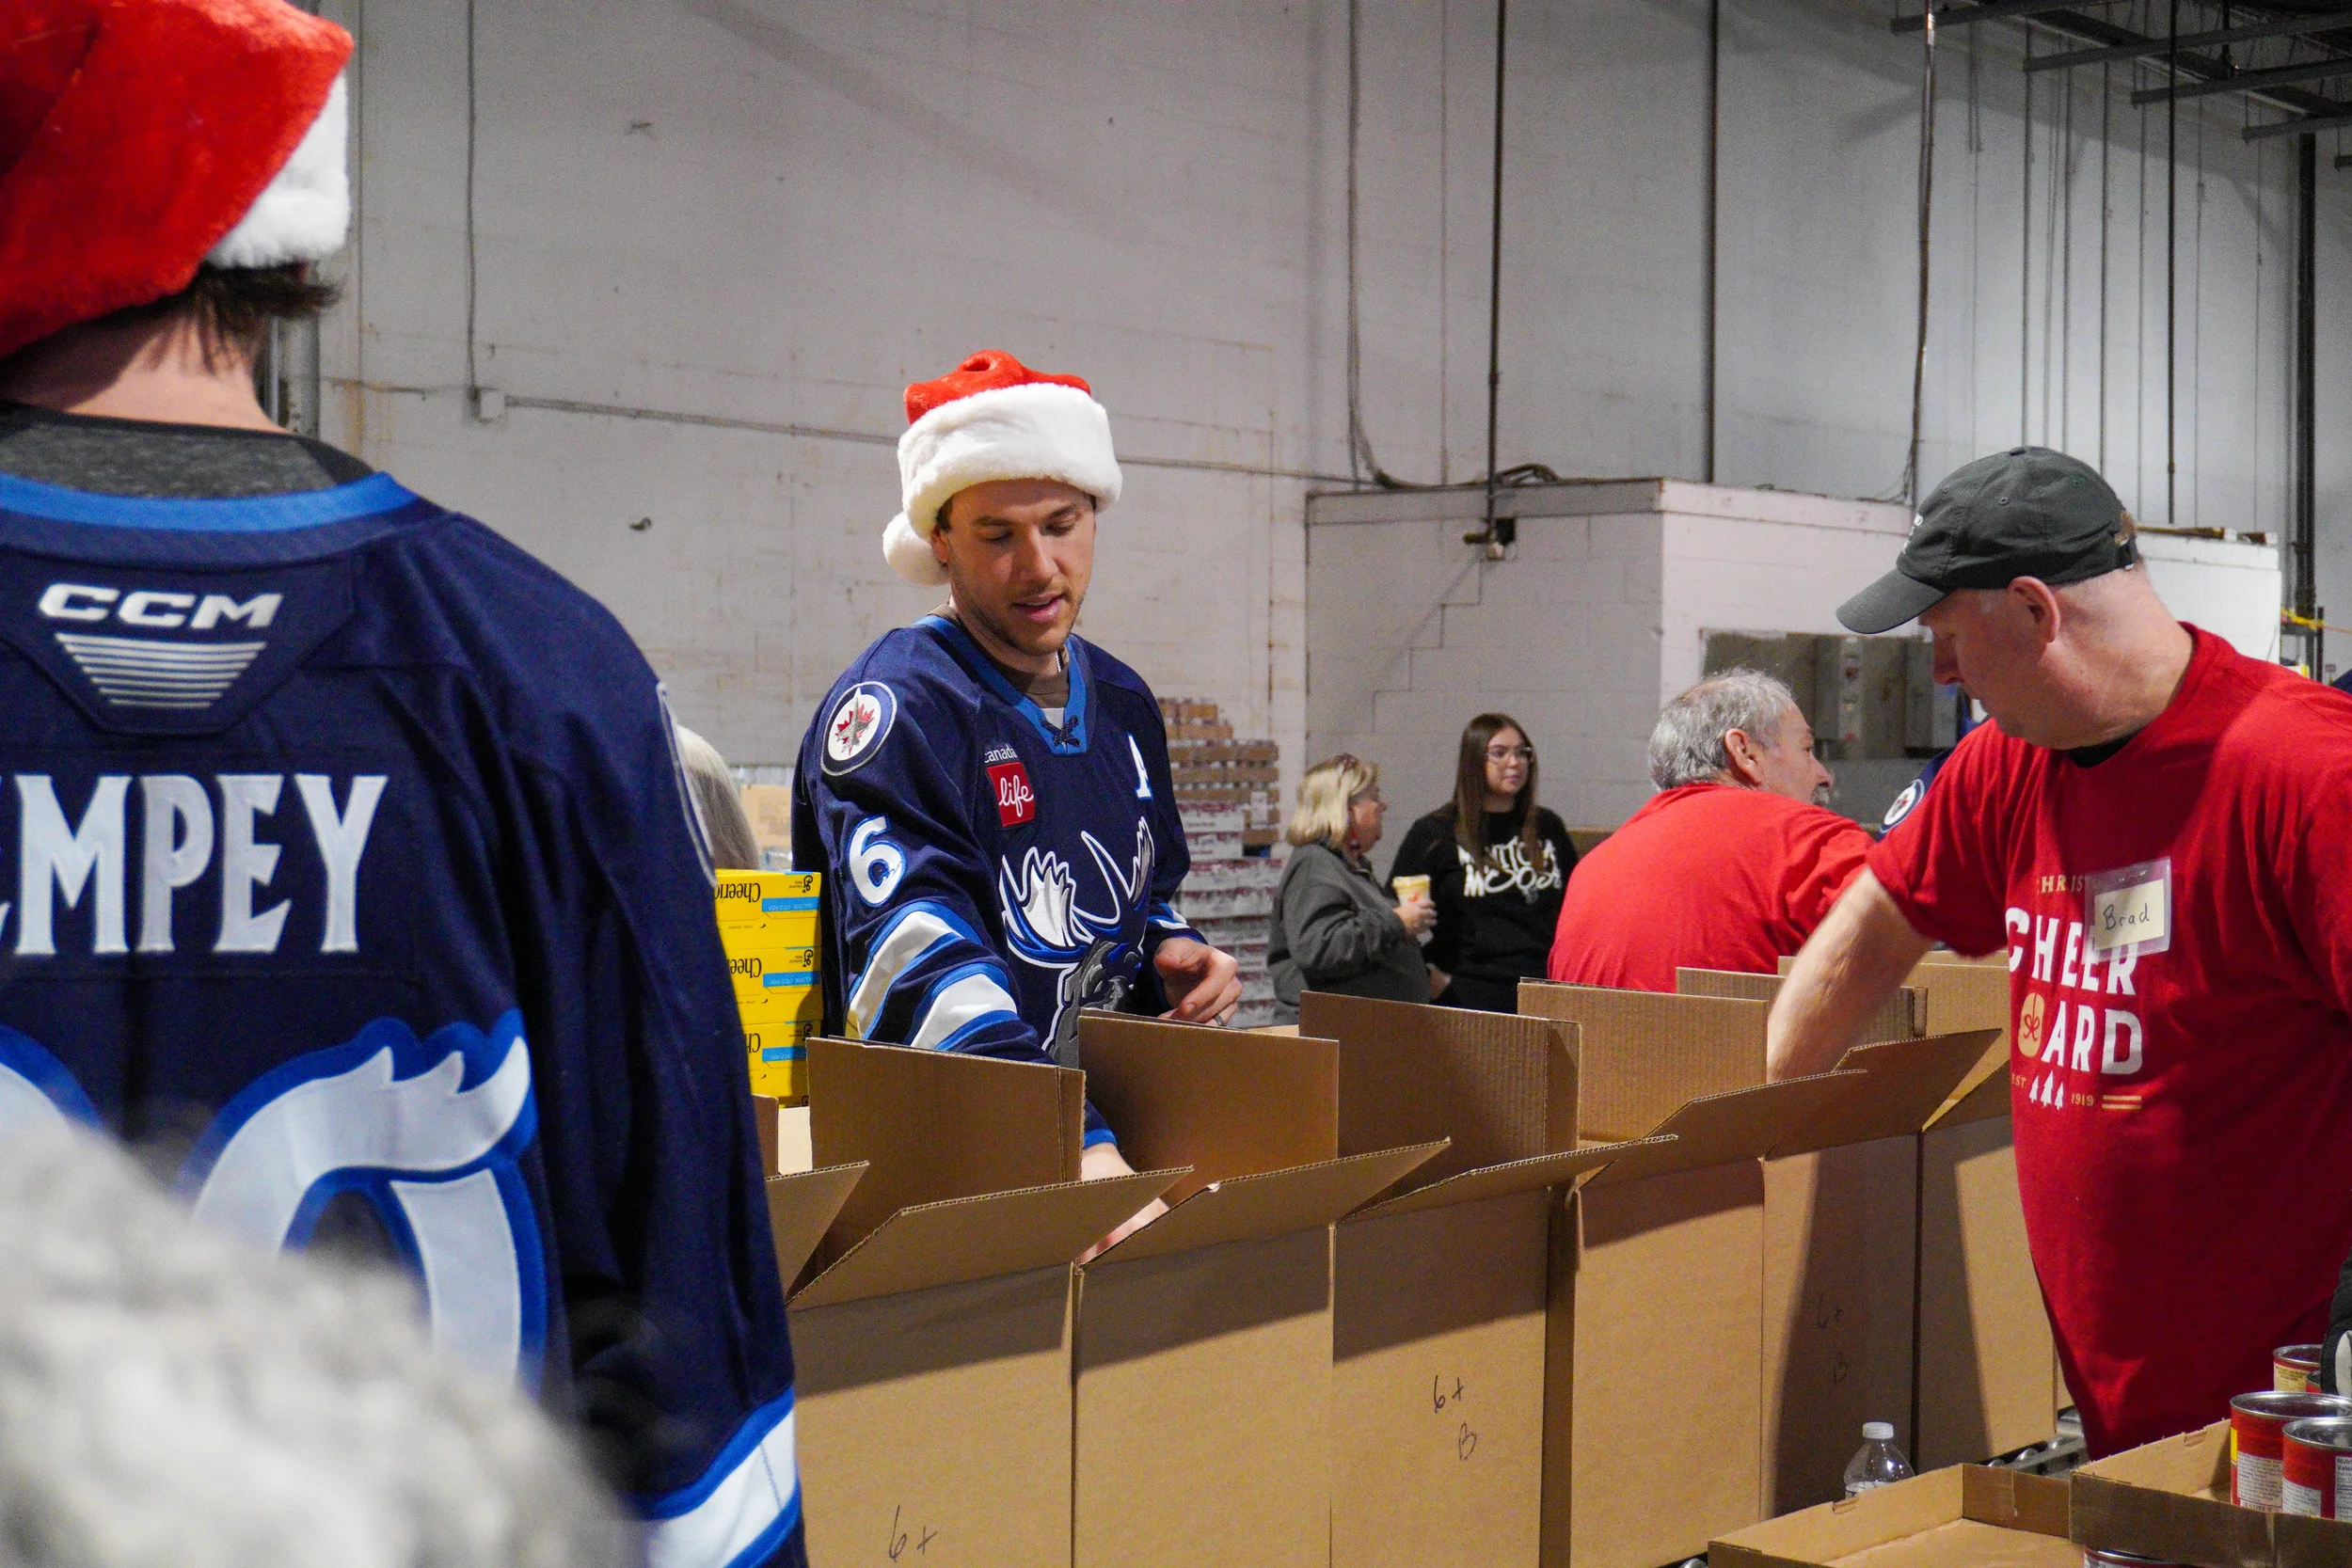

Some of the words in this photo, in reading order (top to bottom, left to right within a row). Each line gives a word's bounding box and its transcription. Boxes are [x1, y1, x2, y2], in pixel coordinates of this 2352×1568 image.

[39, 582, 283, 628] CCM
[998, 775, 1034, 817] life
[0, 773, 389, 956] MPEY
[850, 816, 906, 907] 6
[2104, 902, 2150, 931] Brad
[728, 958, 762, 978] Chee
[2071, 1092, 2094, 1106] 1919
